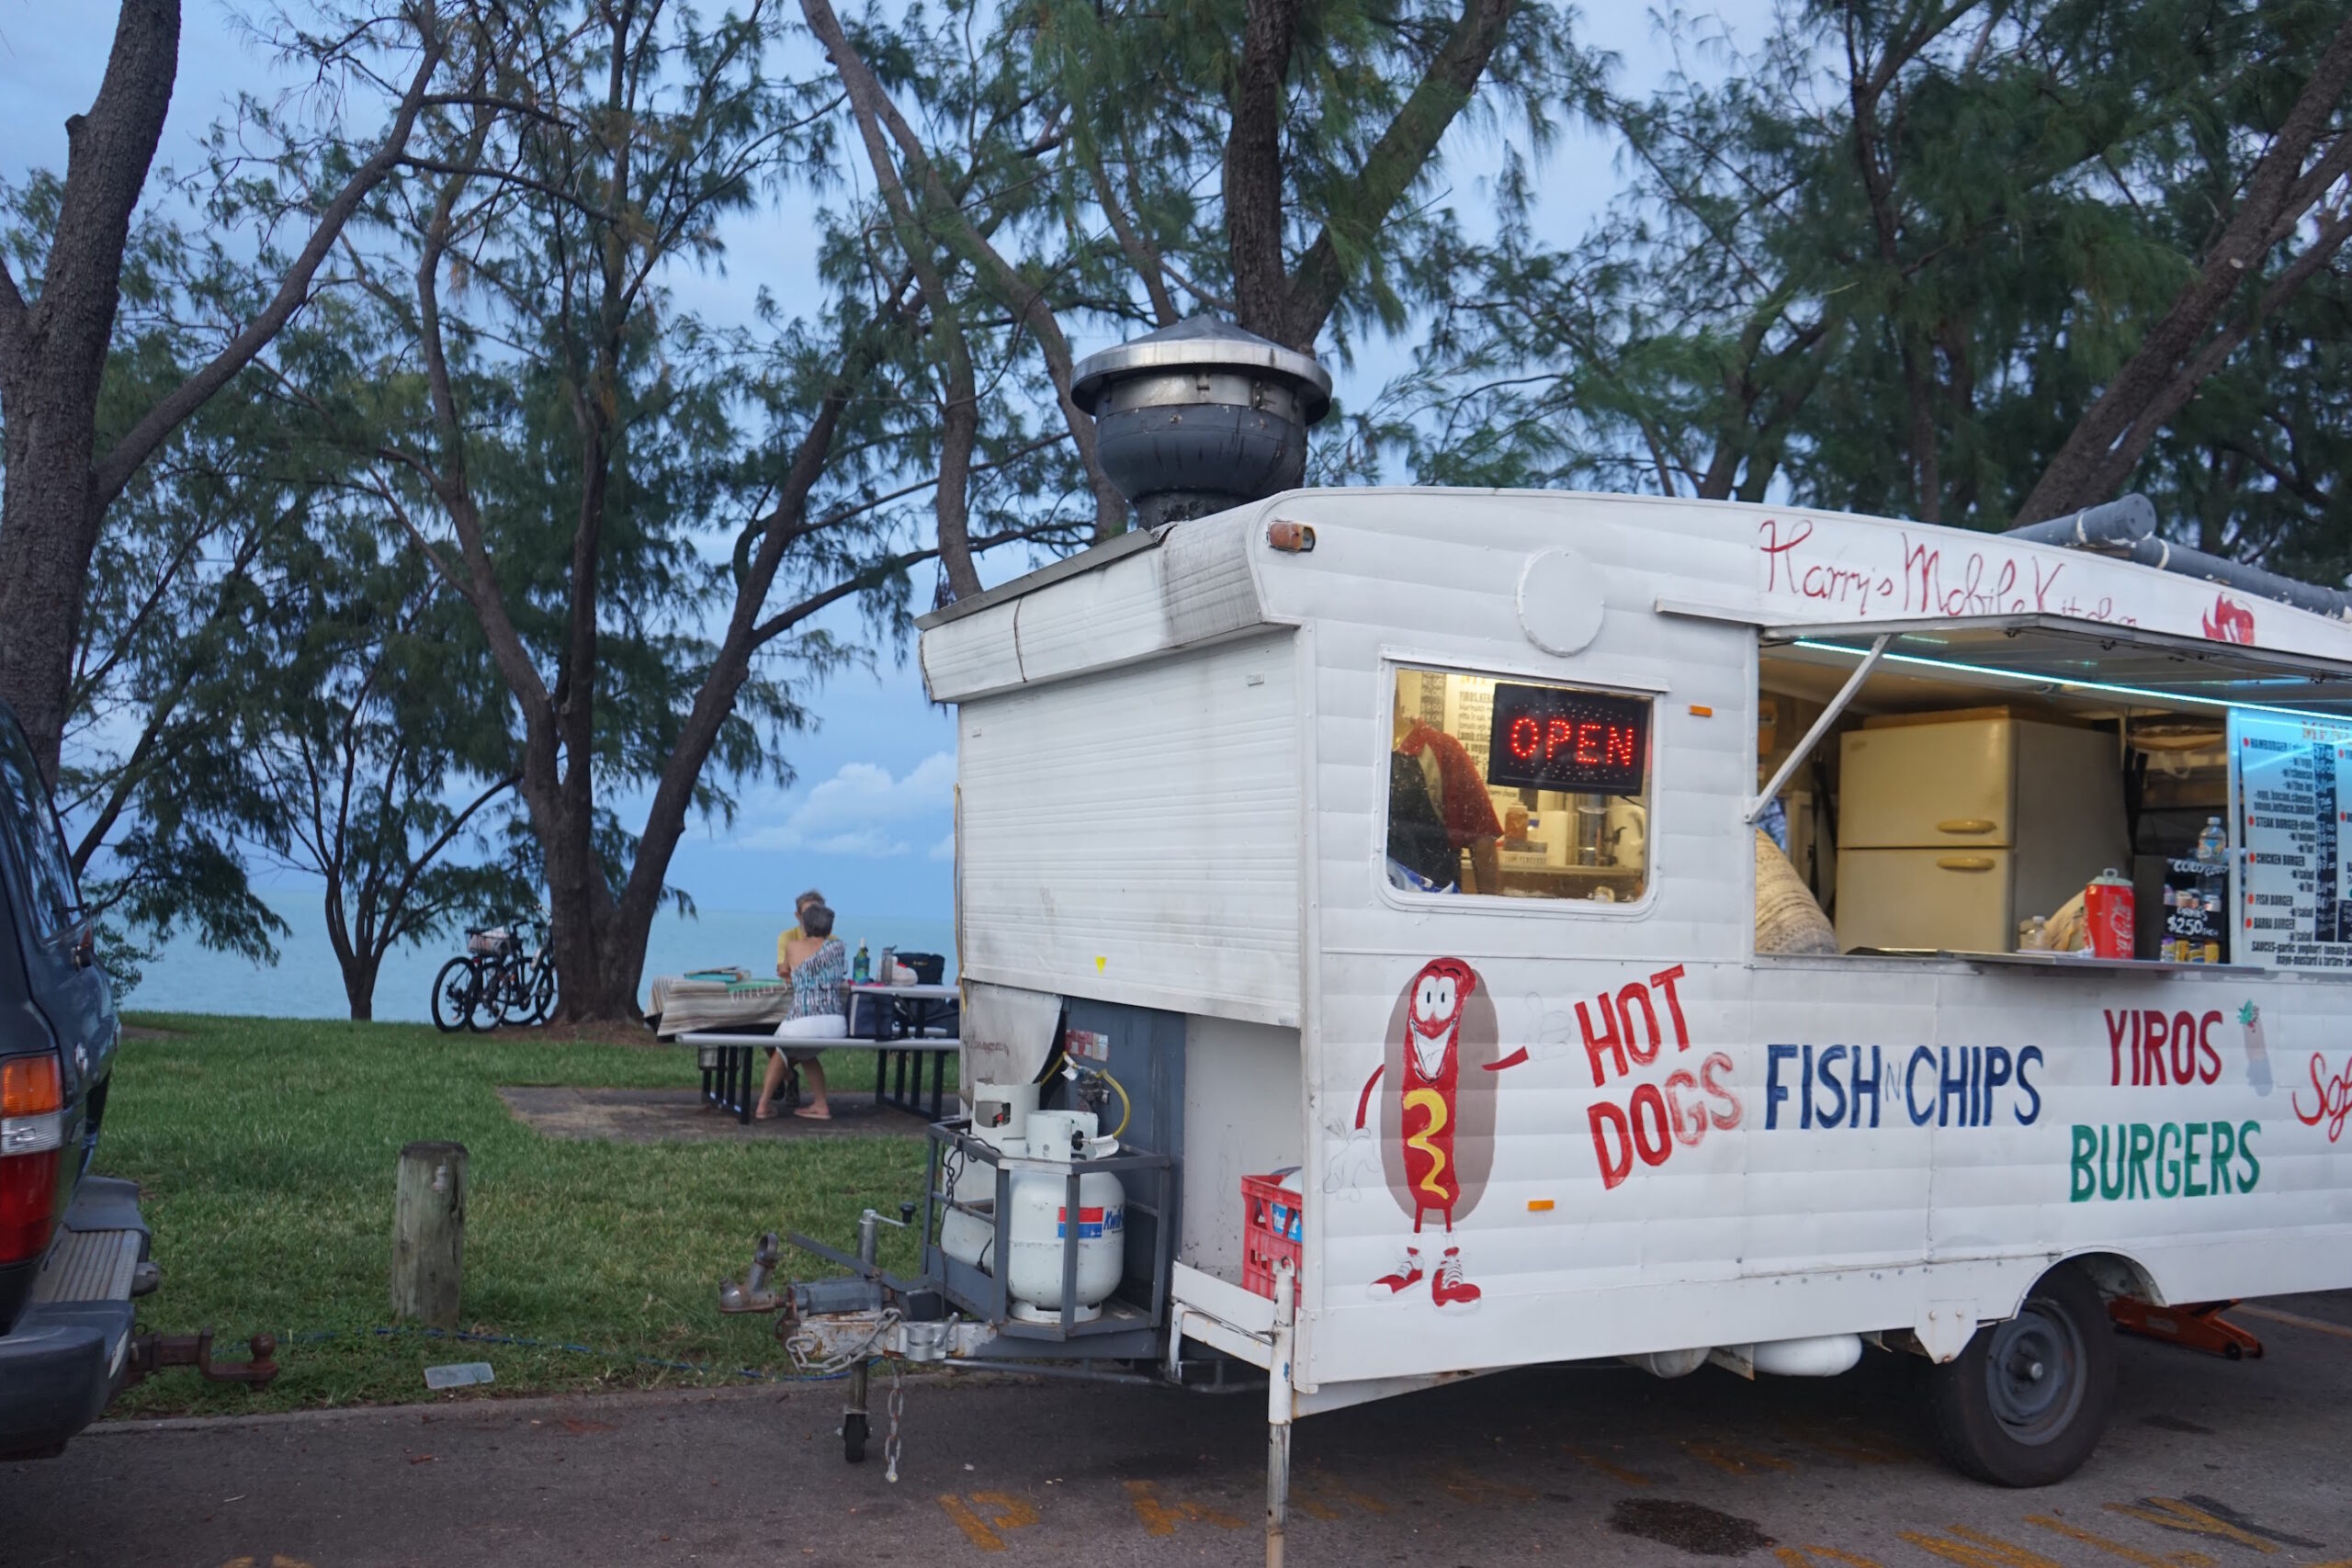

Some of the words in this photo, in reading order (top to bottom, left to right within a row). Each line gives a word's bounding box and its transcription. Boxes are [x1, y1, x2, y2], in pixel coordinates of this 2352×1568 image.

[2031, 555, 2139, 626] Kithn
[1510, 716, 1634, 767] OPEN
[1574, 963, 1690, 1088] HOT
[2103, 1009, 2223, 1087] YIROS
[1587, 1051, 1743, 1190] DOGS
[1764, 1043, 1882, 1130] FISH
[1905, 1044, 2044, 1128] CHIPS
[2292, 1051, 2352, 1144] Sof
[2069, 1120, 2262, 1203] BURGERS
